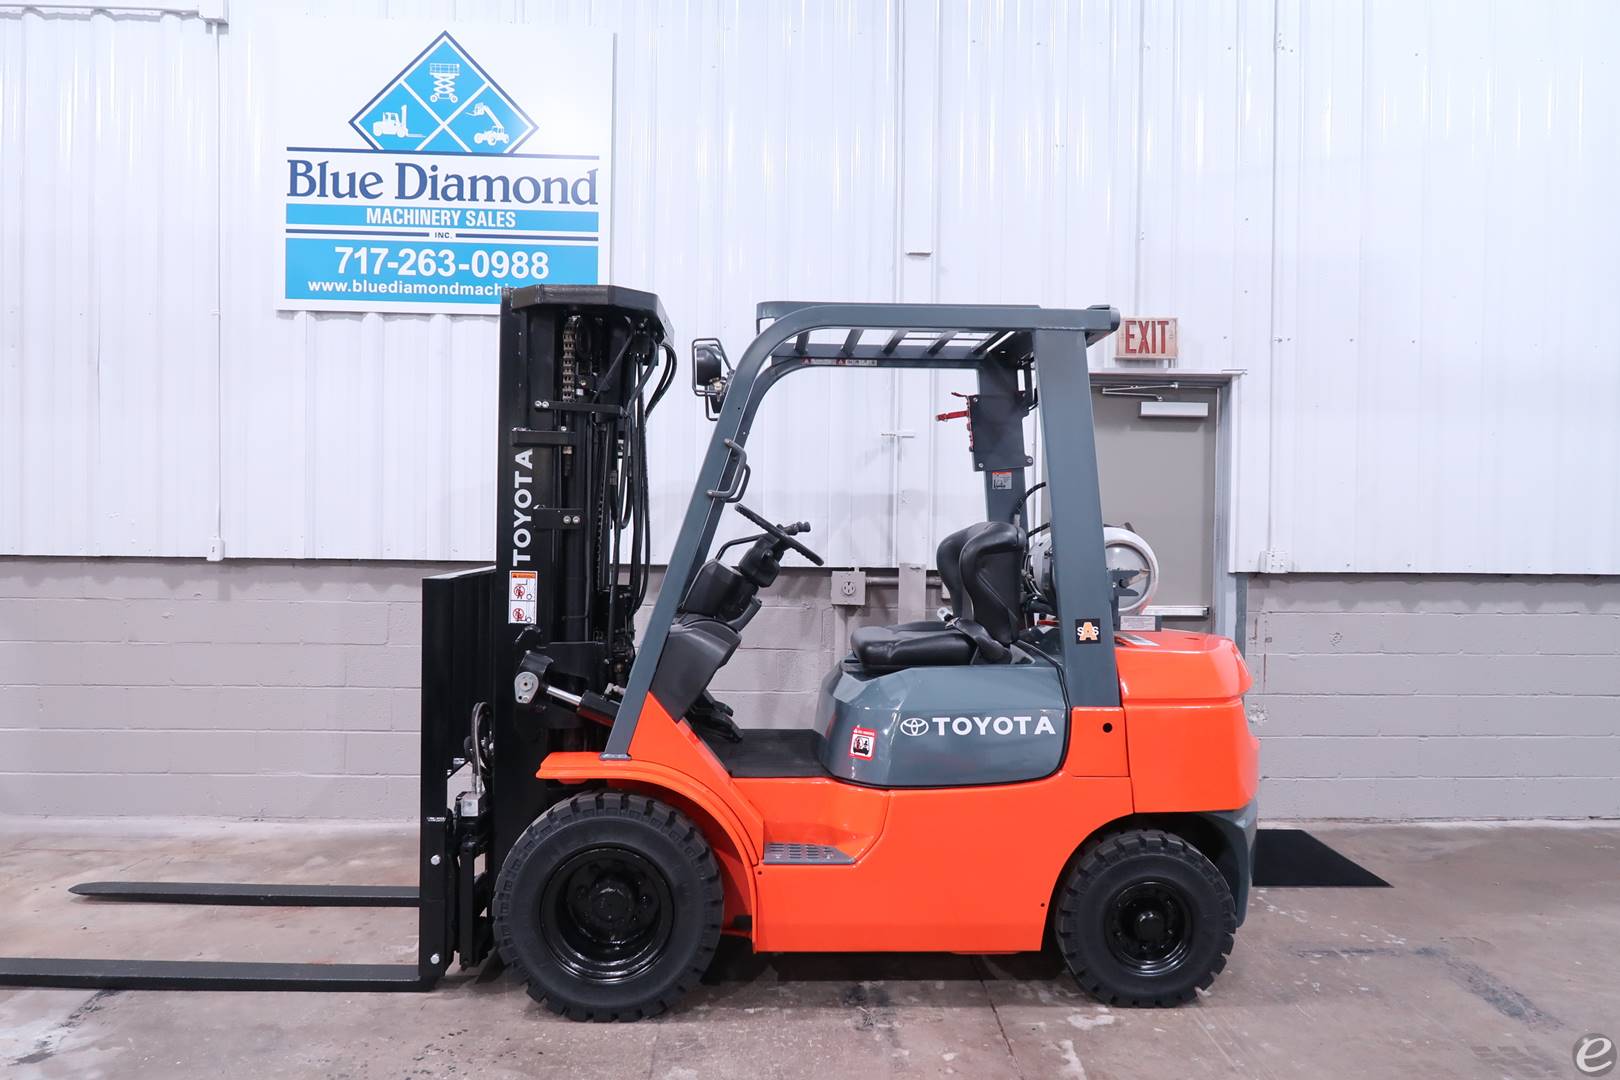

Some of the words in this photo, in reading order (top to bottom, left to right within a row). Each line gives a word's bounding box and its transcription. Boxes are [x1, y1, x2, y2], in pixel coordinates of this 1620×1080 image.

[287, 159, 384, 199] Blue
[395, 162, 599, 205] Diamond
[366, 207, 461, 227] MACHINERY
[465, 210, 516, 228] SALES
[335, 246, 549, 280] 717-263-0988
[1125, 320, 1169, 353] EXIT
[513, 449, 533, 566] TOYOTA
[932, 716, 1056, 736] TOYOTA
